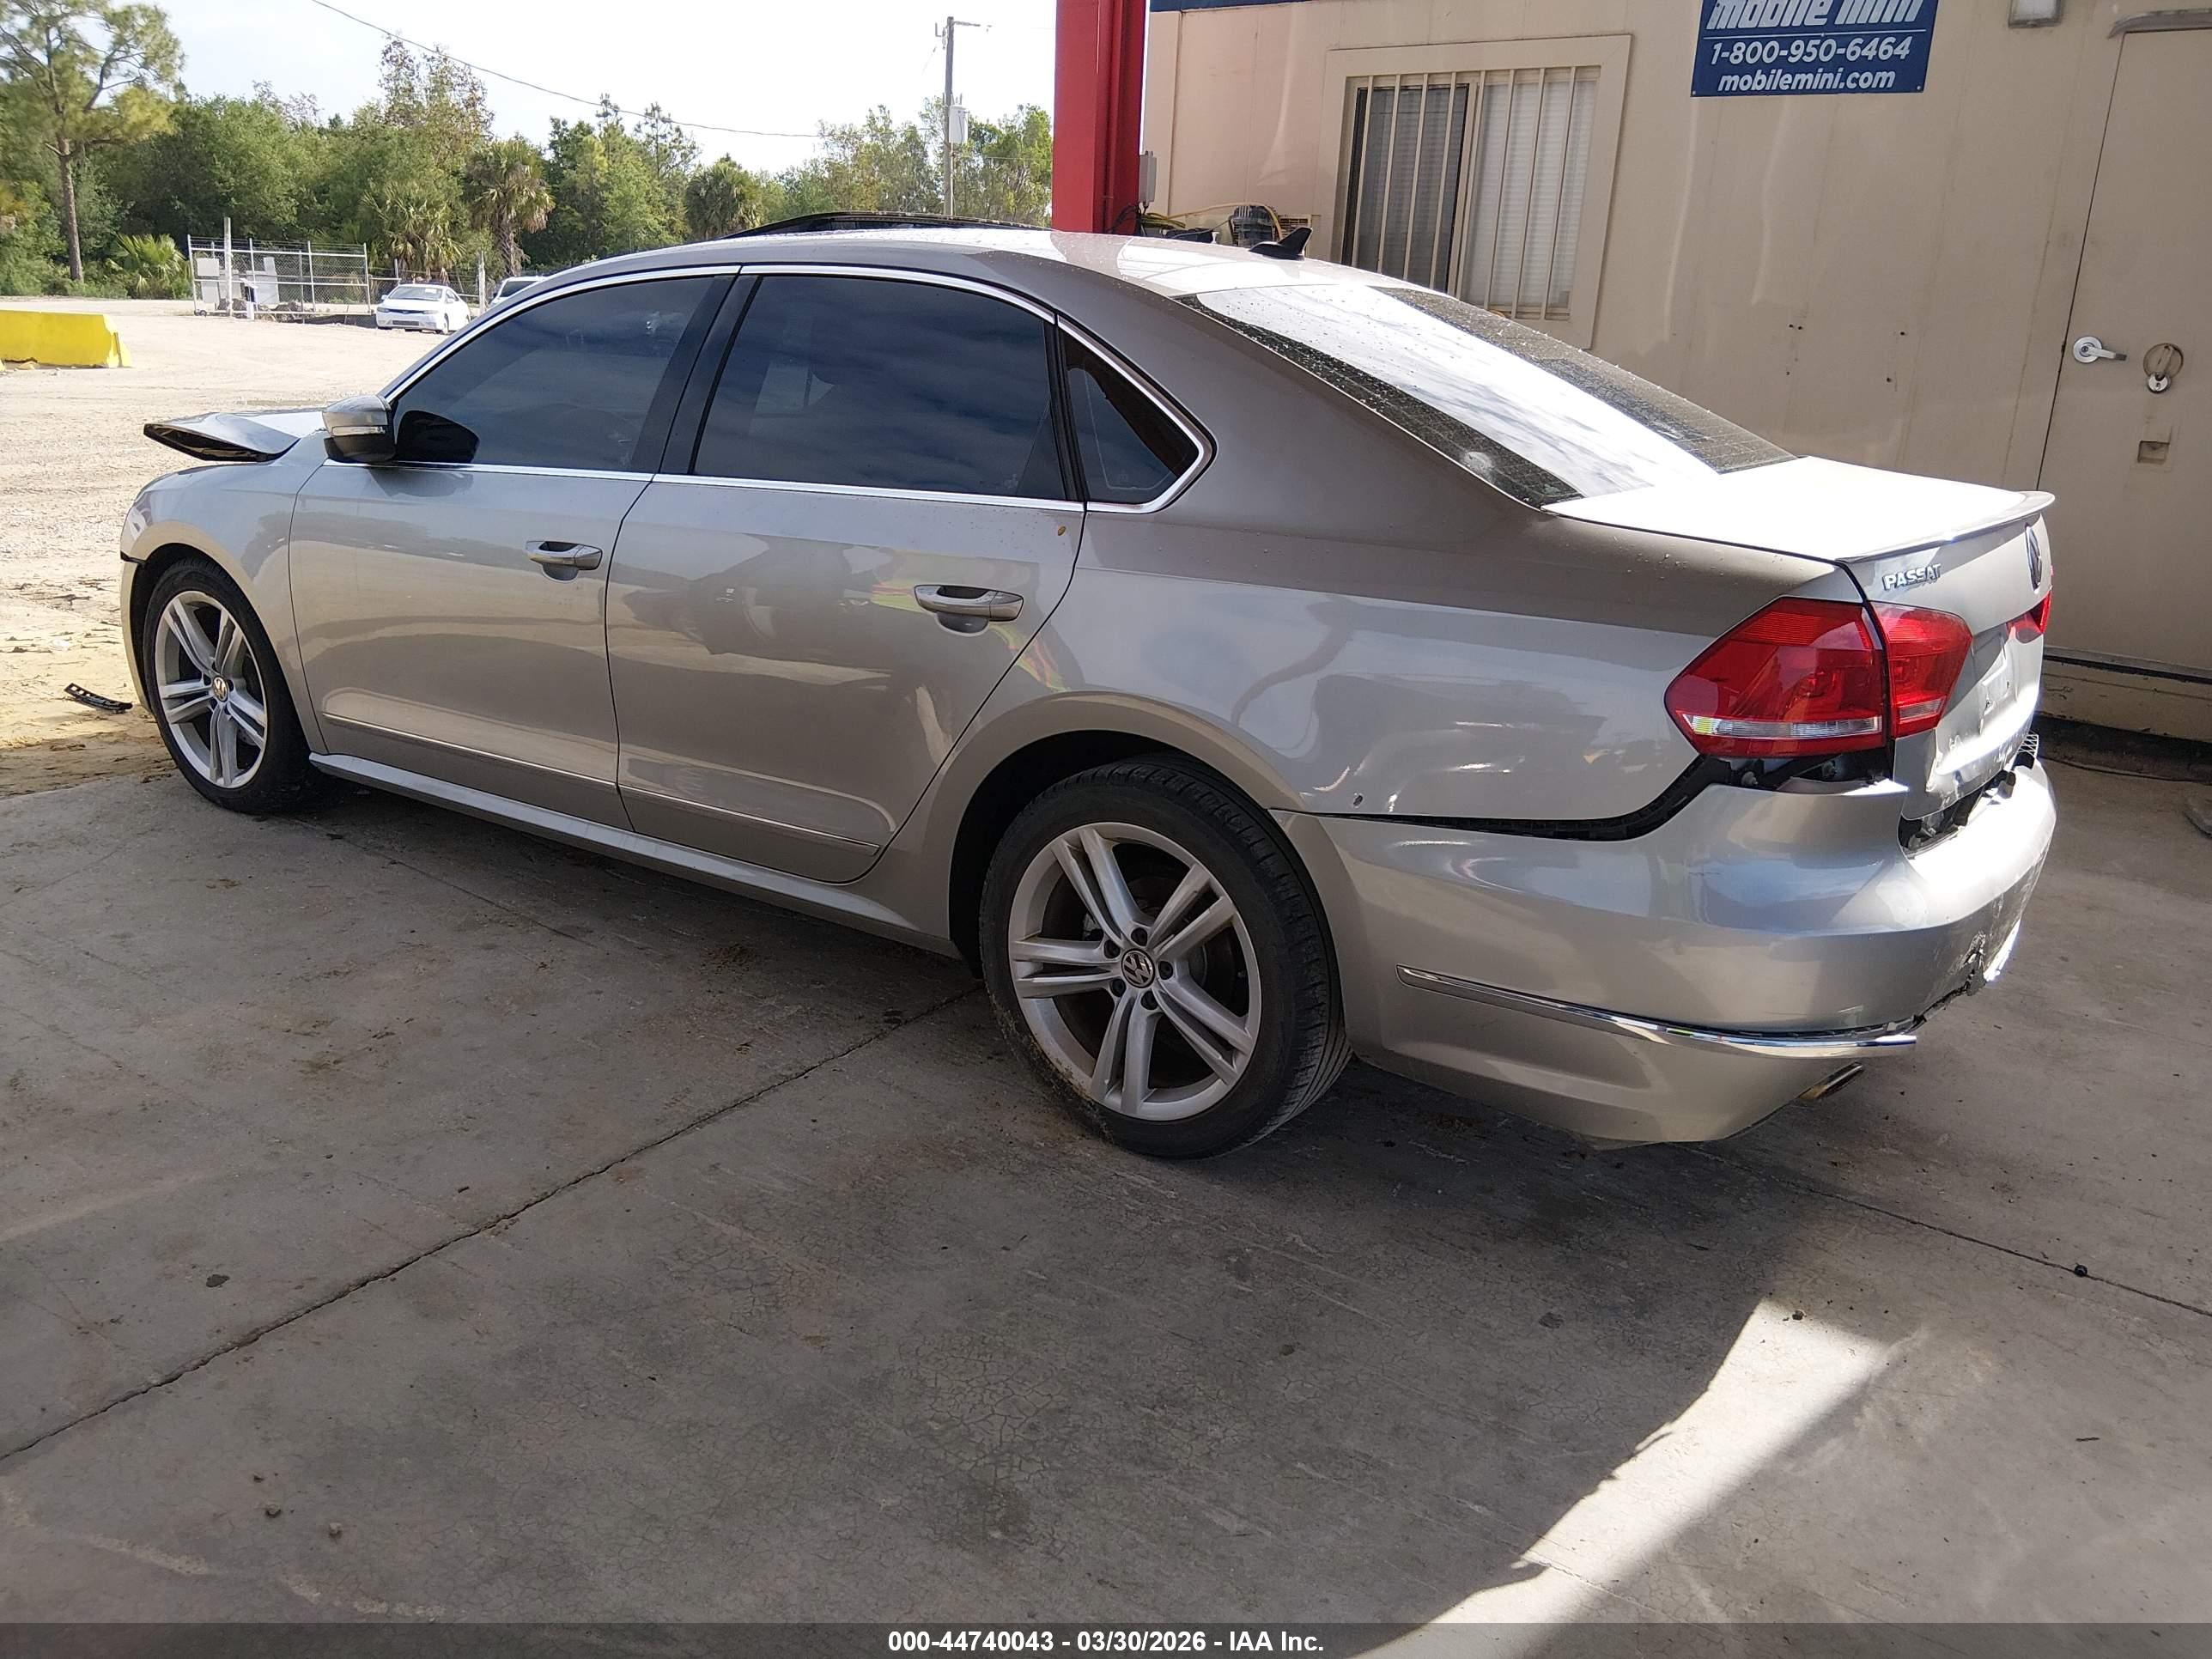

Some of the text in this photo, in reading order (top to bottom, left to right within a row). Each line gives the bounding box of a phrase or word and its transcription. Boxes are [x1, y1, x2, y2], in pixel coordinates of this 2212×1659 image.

[1711, 36, 1912, 65] 1-800-950-6464
[1717, 67, 1896, 91] mobilemini.com
[1882, 563, 1941, 590] PASSAT
